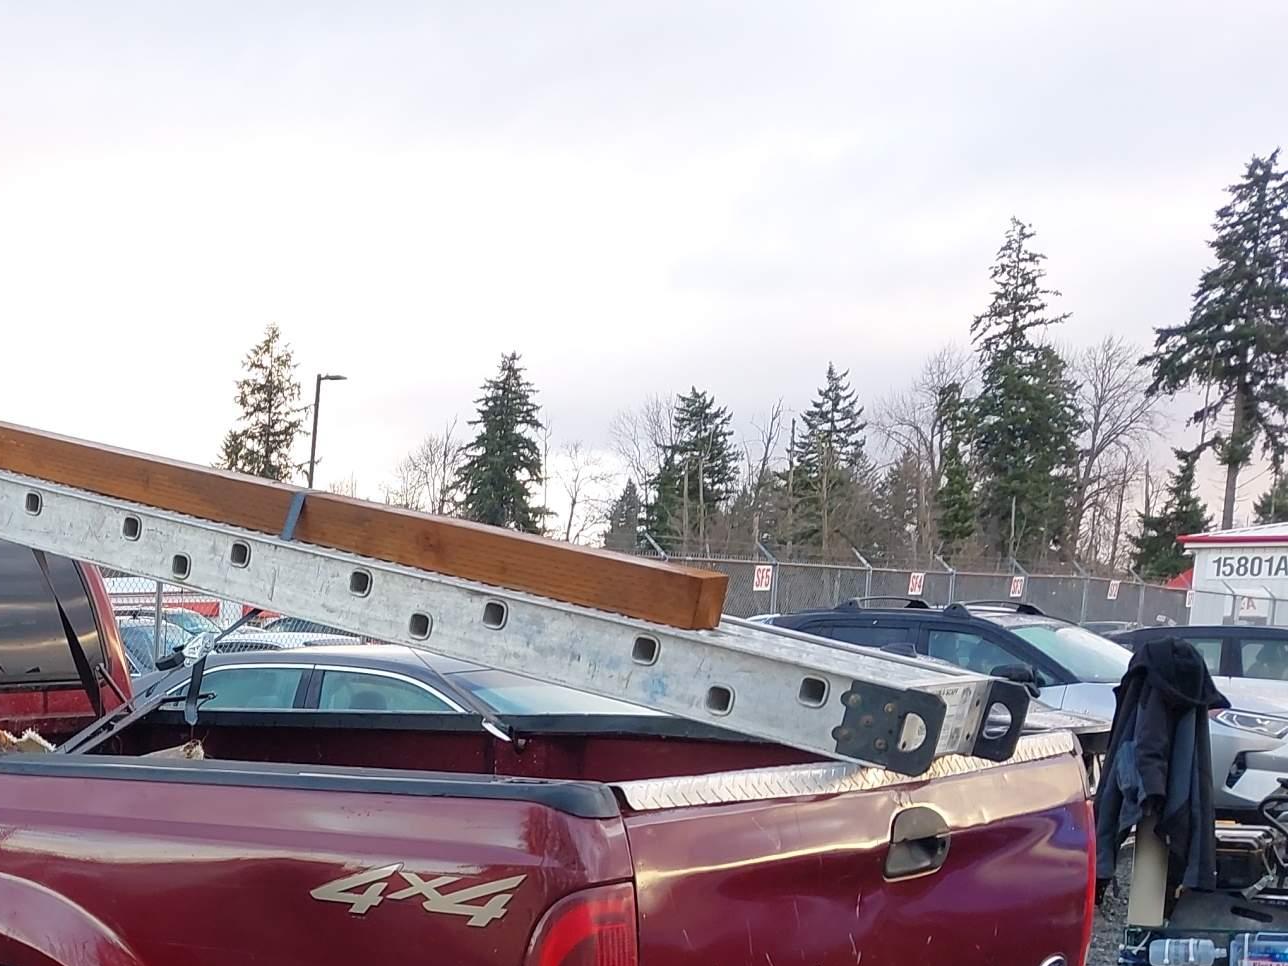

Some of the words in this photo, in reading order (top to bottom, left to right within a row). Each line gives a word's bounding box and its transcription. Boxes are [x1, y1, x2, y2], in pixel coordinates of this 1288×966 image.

[755, 566, 771, 588] SF5
[1212, 555, 1288, 577] 15801A
[910, 574, 923, 593] SF4
